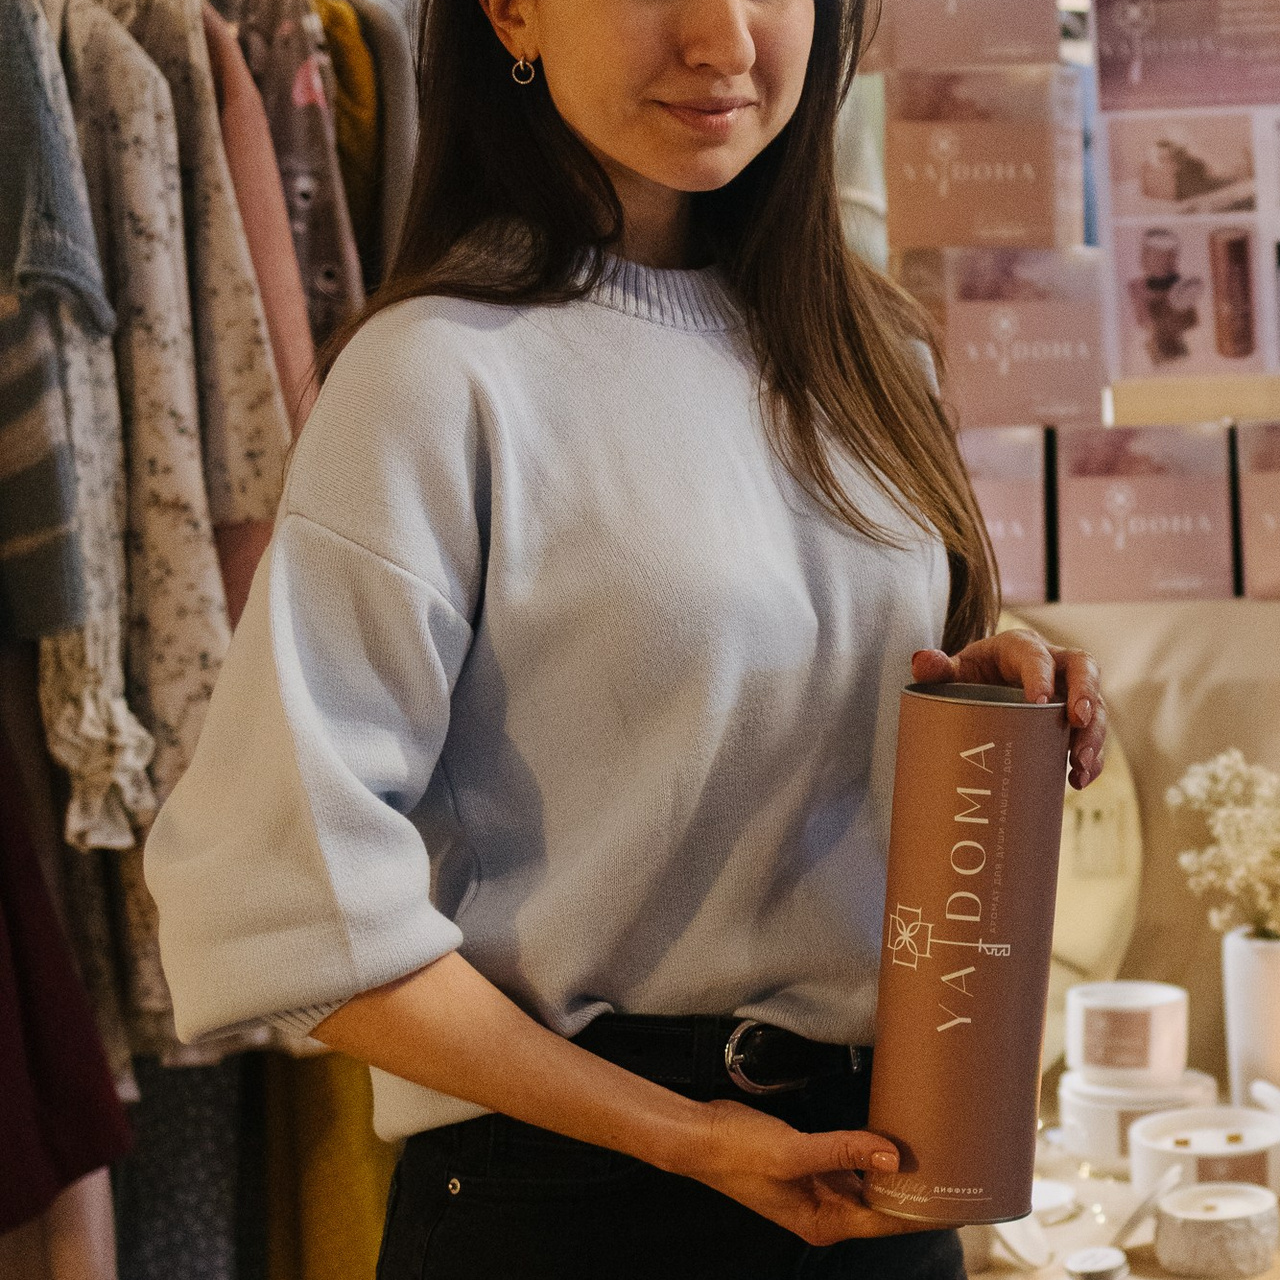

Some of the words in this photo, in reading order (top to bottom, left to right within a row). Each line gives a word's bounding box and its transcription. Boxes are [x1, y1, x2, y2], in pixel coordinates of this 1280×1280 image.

[1003, 741, 1013, 773] ДОМА
[1000, 777, 1010, 822] ВАШЕГО
[996, 825, 1005, 859] ДУШИ
[989, 888, 1000, 934] АРОМАТ
[932, 1185, 985, 1196] ДИФФУЗОР
